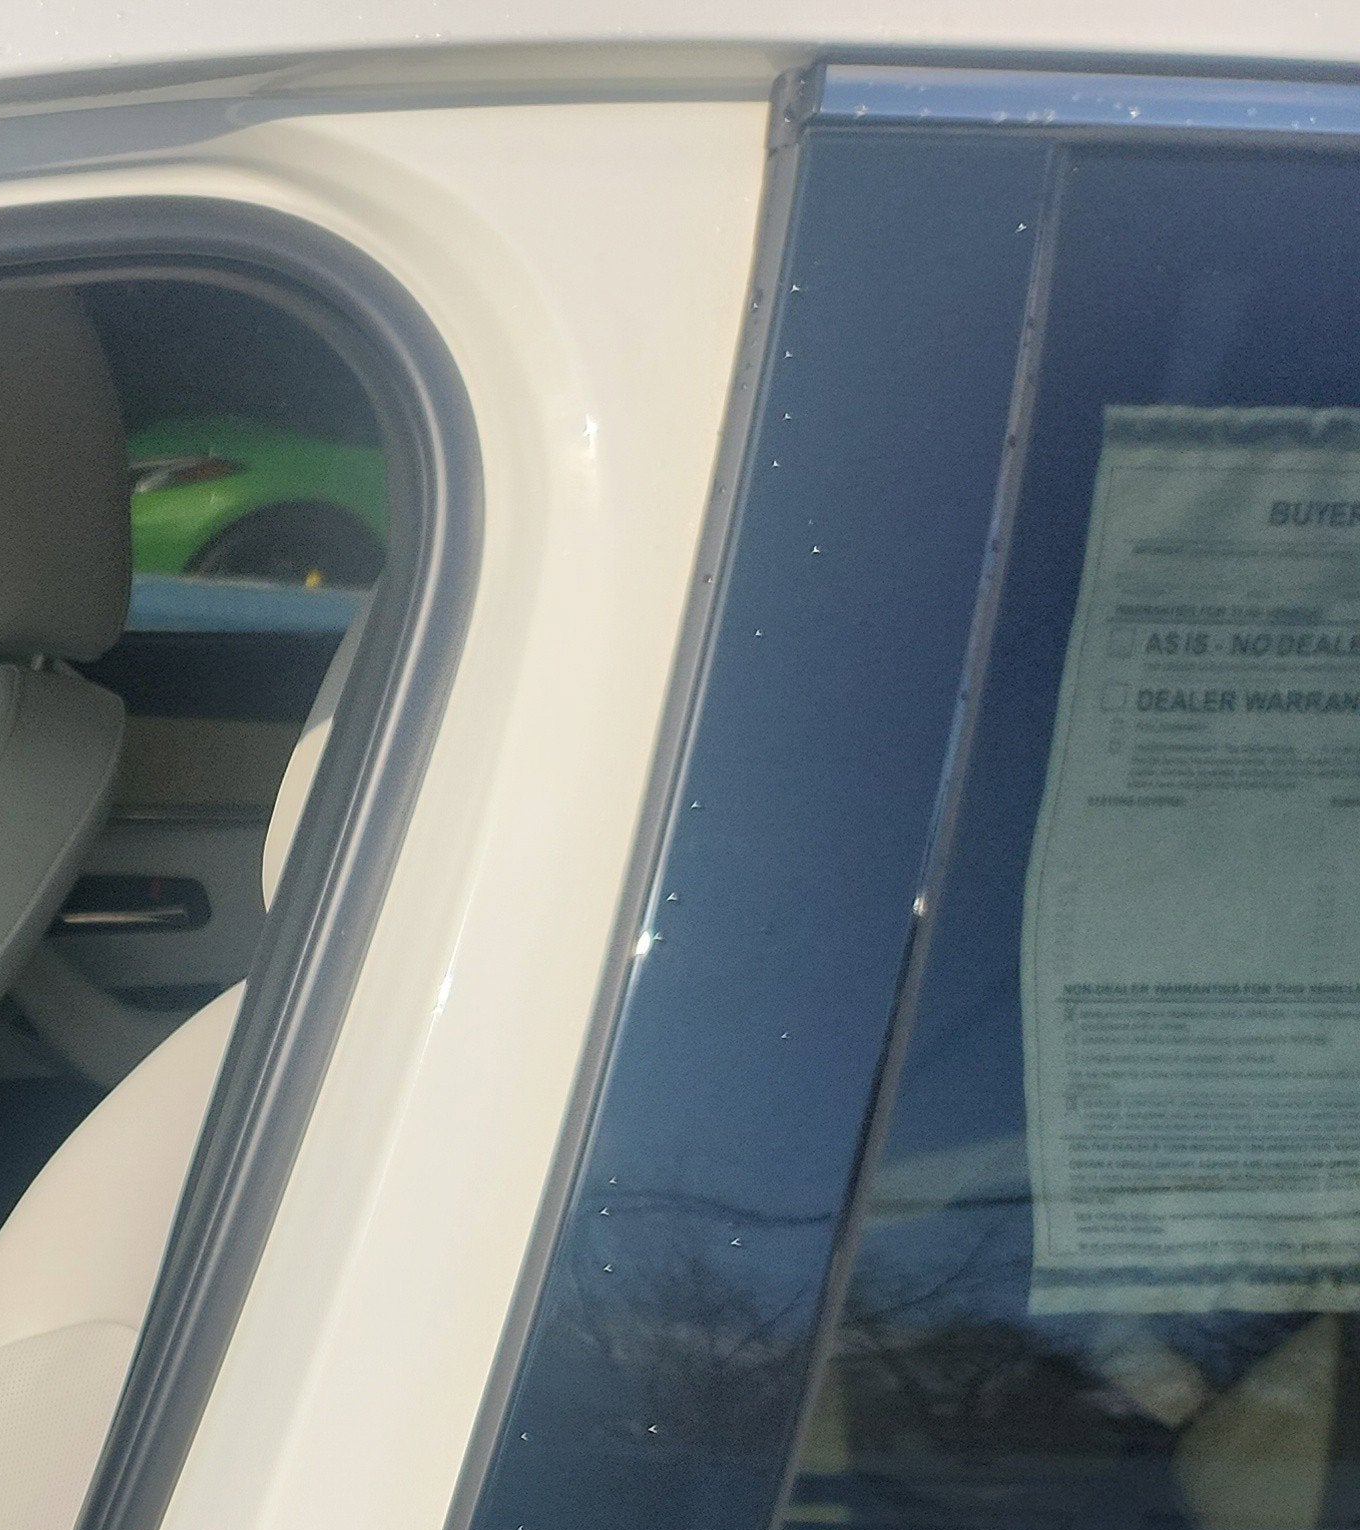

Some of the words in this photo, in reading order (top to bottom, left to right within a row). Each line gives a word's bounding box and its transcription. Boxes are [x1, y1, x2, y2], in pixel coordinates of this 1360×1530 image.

[1145, 632, 1179, 655] AS
[1184, 632, 1209, 655] IS
[1231, 633, 1274, 656] NO
[1137, 688, 1236, 713] DEALER
